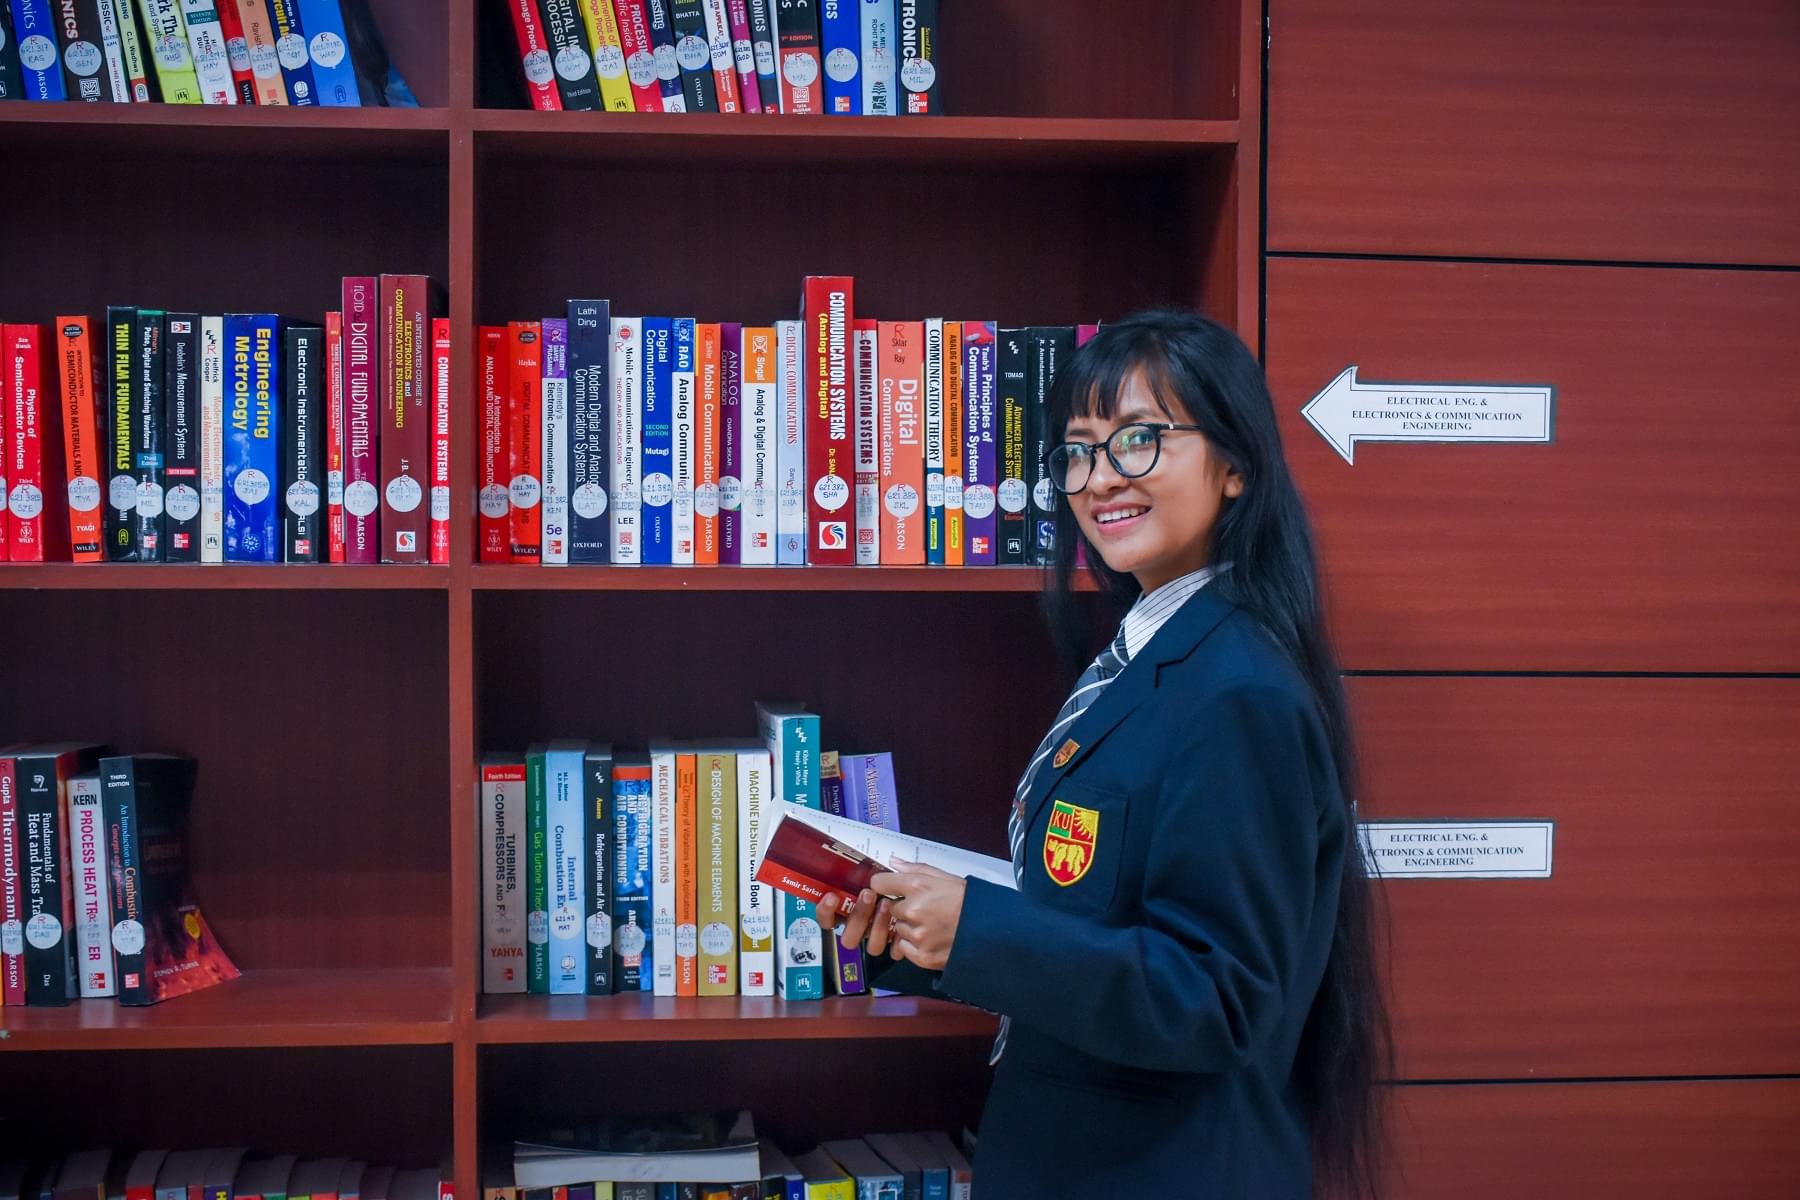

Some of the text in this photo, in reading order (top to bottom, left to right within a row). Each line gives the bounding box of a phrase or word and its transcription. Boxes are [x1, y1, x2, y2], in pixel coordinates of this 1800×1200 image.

[623, 19, 634, 47] Inside
[675, 11, 700, 19] BHATTA
[130, 45, 139, 73] Wadhwa
[577, 88, 591, 96] Edition
[695, 78, 703, 107] OXFORD
[353, 285, 364, 313] FLOYD
[577, 307, 597, 316] Lathi
[577, 317, 597, 327] Ding
[297, 337, 307, 395] Electronic
[351, 322, 368, 367] DIGITAL
[395, 288, 404, 428] COMMUNICATION ENGINEERING
[404, 320, 412, 380] ELECTRONICS
[657, 330, 668, 363] Digital
[679, 345, 689, 368] RAO
[818, 313, 829, 419] (Analog and Digital)
[829, 292, 845, 440] COMMUNICATION SYSTEMS
[15, 356, 24, 429] Semiconductor
[203, 357, 211, 383] Cooper
[210, 357, 219, 383] Helfrick
[232, 336, 249, 430] Metrology
[254, 328, 272, 438] Engineering
[486, 355, 494, 424] ANALOG DIGITAL
[645, 330, 656, 412] Communication
[704, 364, 714, 400] Mobile
[728, 350, 738, 406] ANALOG
[786, 336, 797, 445] DIGITAL COMMUNICATIONS
[27, 389, 36, 438] Physics of
[67, 350, 80, 453] SEMICONDUCTOR MATERIALS
[115, 323, 130, 470] THIN FILM FUNDAMENTALS
[142, 347, 151, 449] Digital Switching Waveforms
[176, 372, 187, 426] Measurement
[351, 371, 369, 458] FUNDAMENTALS
[437, 356, 449, 482] COMMUNICATION SYSTEMS
[494, 395, 501, 405] An
[587, 365, 601, 451] Modern Digital and
[625, 347, 633, 445] Mobile Communications
[677, 378, 689, 419] Analog
[860, 339, 872, 465] COMMUNICATION SYSTEMS
[895, 378, 918, 445] Digital
[927, 329, 940, 463] COMMUNICATION THEORY
[966, 347, 980, 483] Communication Systems
[980, 374, 992, 443] Principles of
[1352, 410, 1522, 421] ELECTRONICS & COMMUNICATION
[1387, 397, 1450, 406] ELECTRICAL
[1455, 398, 1478, 406] ENG.
[546, 382, 555, 484] Electronic Communication
[574, 369, 588, 482] Communication Systems
[754, 389, 766, 451] Analog Digital
[882, 377, 894, 476] Communications
[1402, 422, 1472, 431] ENGINEERING
[16, 432, 25, 469] Devices
[176, 428, 187, 460] Systems
[645, 448, 669, 456] Mutagi
[546, 524, 562, 535] 5e
[1, 776, 11, 804] Gupta
[73, 794, 97, 806] KERN
[28, 813, 40, 839] Heat
[42, 812, 53, 871] Fundamentals
[121, 816, 131, 858] Introduction
[495, 793, 505, 880] COMPRESSORS
[534, 832, 543, 849] Gas
[616, 794, 627, 884] AIR CONDITIONING
[658, 765, 669, 884] MECHANICAL VIBRATIONS
[711, 771, 722, 913] DESIGN OF MACHINE ELEMENTS
[749, 770, 760, 909] MACHINE Book
[1053, 810, 1070, 829] KU
[1390, 833, 1488, 843] ELECTRICAL ENG. &
[29, 842, 41, 863] and
[80, 810, 97, 897] PROCESS HEAT
[506, 835, 516, 894] TURBINES,
[534, 852, 543, 883] Turbine
[555, 825, 566, 892] Combustion
[594, 833, 604, 896] Refrigeration and
[683, 828, 691, 861] Vibrations
[1404, 857, 1474, 866] ENGINEERING
[1427, 848, 1434, 856] &
[1437, 847, 1524, 856] COMMUNICATION
[31, 866, 42, 895] Mass
[567, 857, 577, 900] Internal
[781, 876, 823, 897] Samir Sarkar
[491, 947, 523, 957] YAHYA
[43, 974, 51, 986] Das
